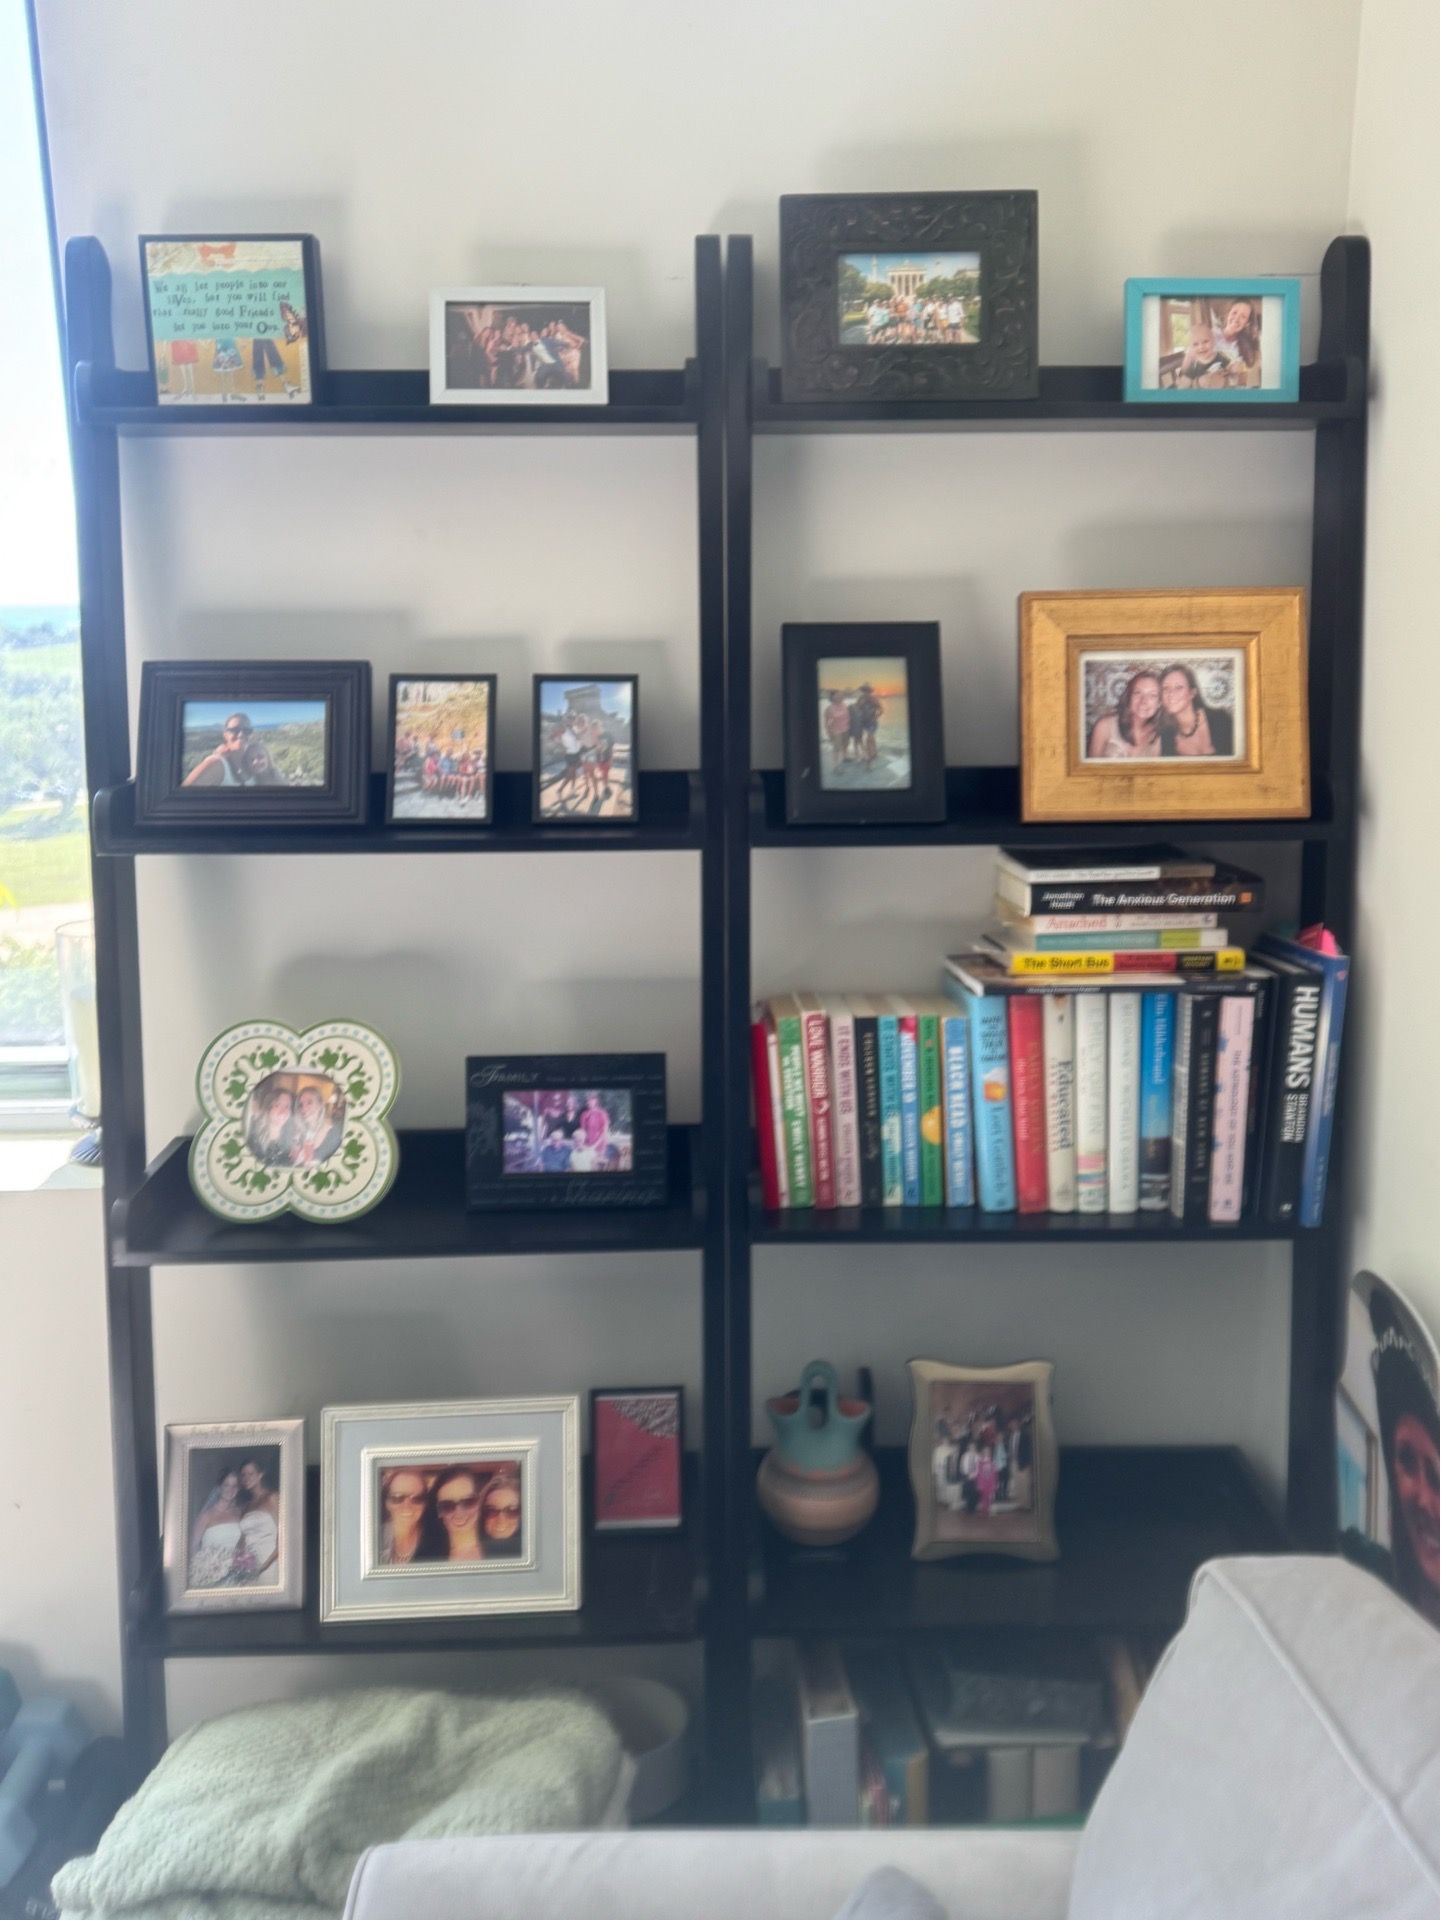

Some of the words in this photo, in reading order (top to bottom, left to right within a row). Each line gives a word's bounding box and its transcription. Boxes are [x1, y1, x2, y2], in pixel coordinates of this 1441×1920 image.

[194, 280, 208, 291] let
[215, 280, 244, 291] people
[249, 279, 268, 290] into
[227, 293, 242, 304] you
[247, 293, 267, 302] will
[272, 292, 290, 302] find
[234, 320, 253, 331] your
[1042, 891, 1085, 901] Jonathan
[1093, 894, 1115, 906] The
[1115, 893, 1166, 906] Anxious
[1167, 892, 1236, 906] Generation
[1023, 956, 1047, 969] The
[1049, 956, 1083, 969] Short
[1086, 955, 1110, 968] Bus
[808, 1019, 824, 1049] LOVE
[1151, 1018, 1169, 1085] Hilderbrand
[1284, 986, 1321, 1090] HUMANS
[810, 1048, 827, 1099] WARRIOR
[948, 1046, 965, 1092] BEACH
[950, 1093, 967, 1129] READ
[1057, 1059, 1073, 1150] Educated
[1281, 1092, 1299, 1144] STANTON
[1294, 1093, 1309, 1144] BRANDON
